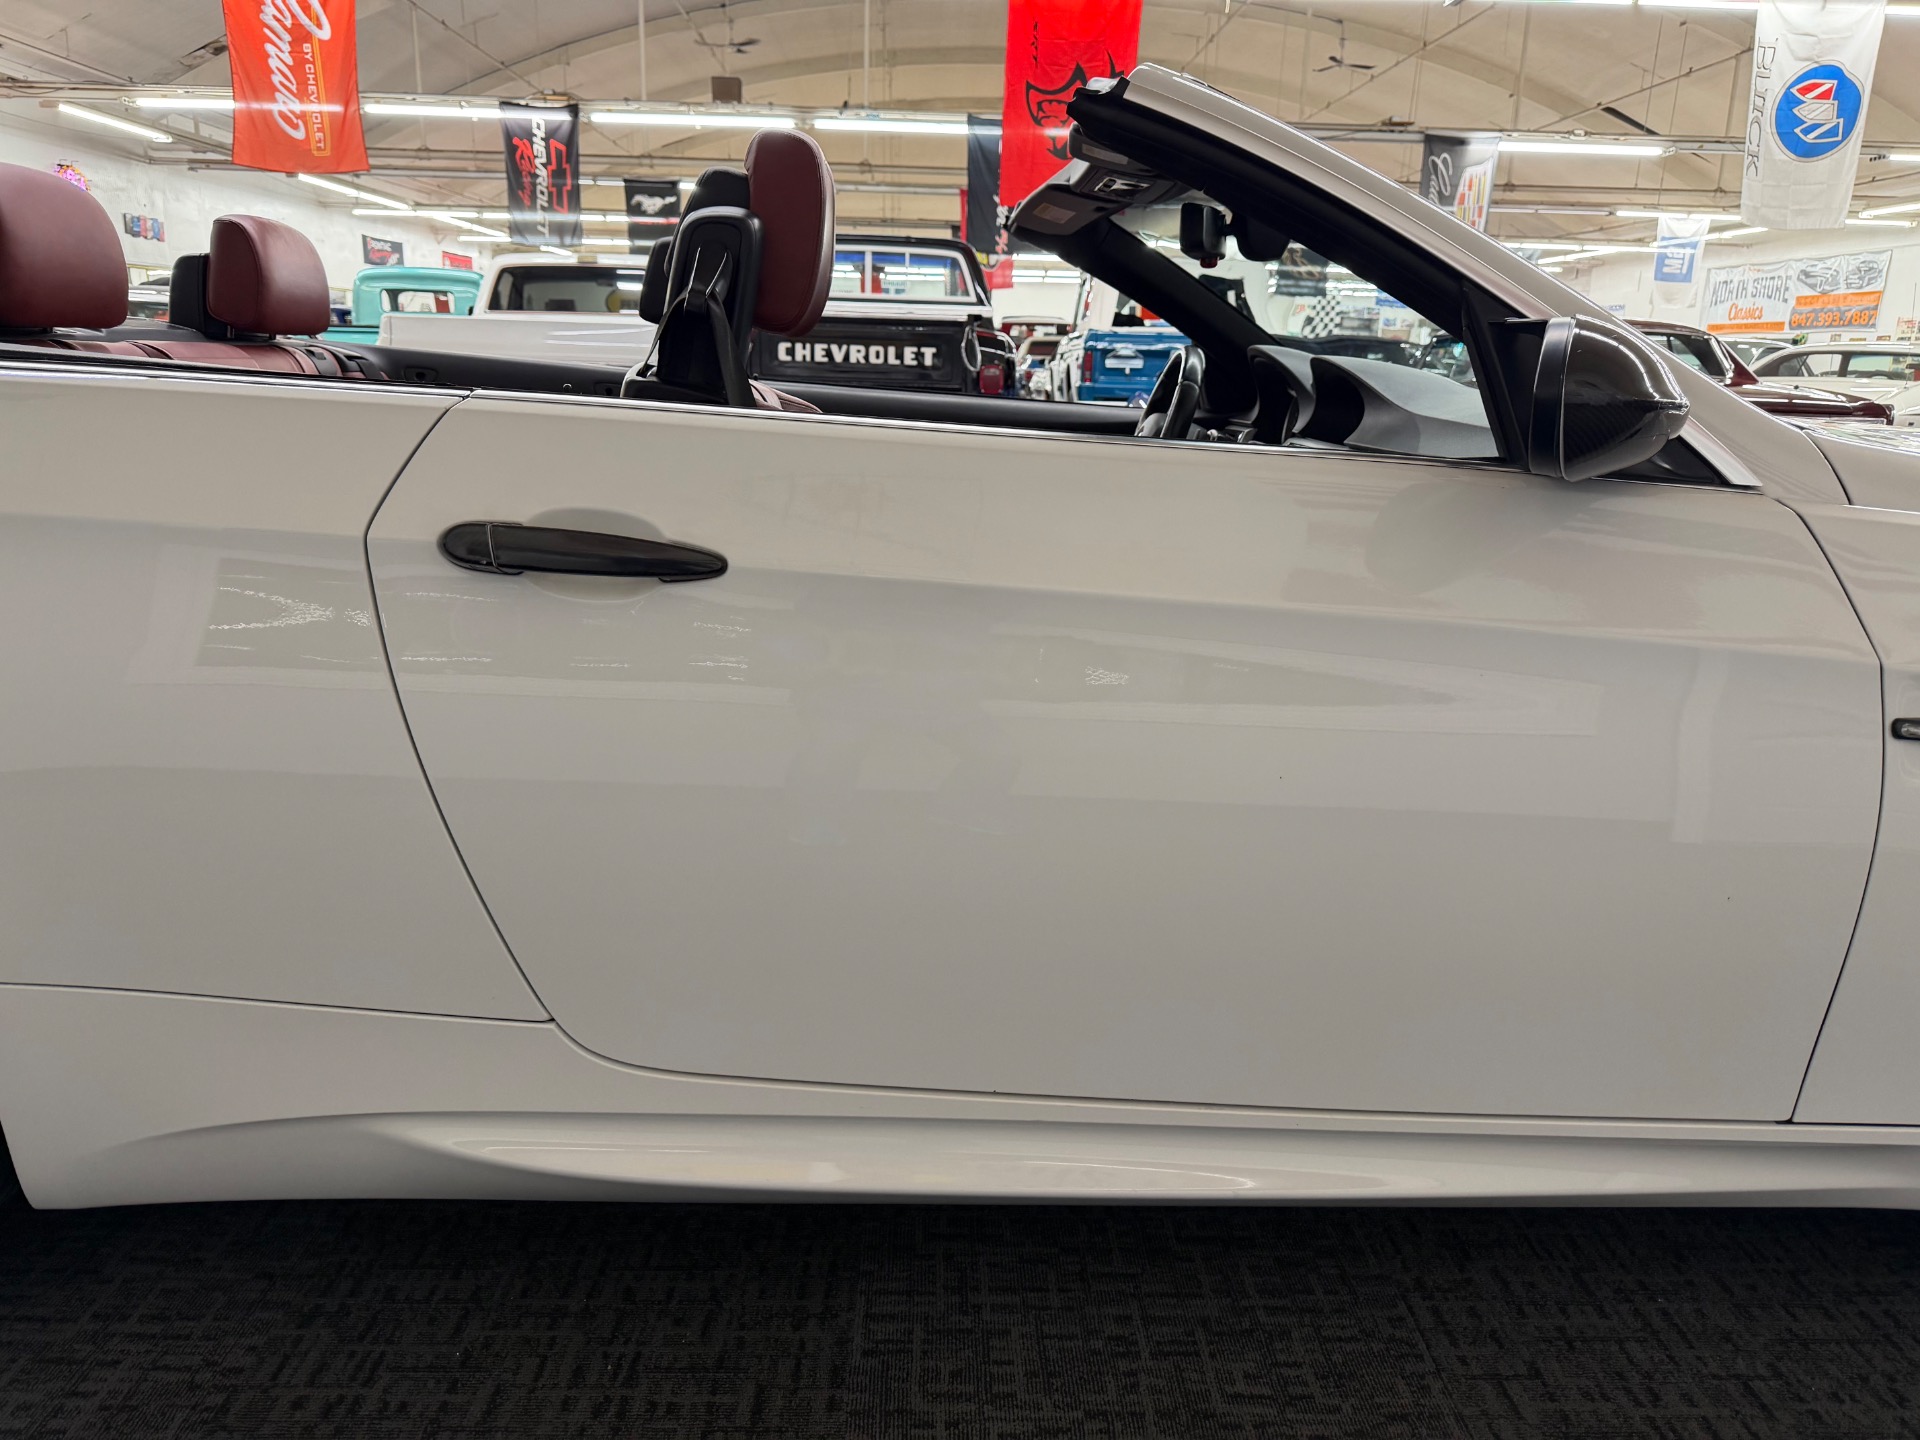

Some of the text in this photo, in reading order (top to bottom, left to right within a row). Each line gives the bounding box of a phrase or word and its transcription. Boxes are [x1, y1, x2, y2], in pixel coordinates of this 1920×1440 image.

[303, 43, 324, 149] BY CHEVOLET
[1746, 37, 1776, 177] BUICK
[1710, 278, 1749, 307] NORTH
[1751, 274, 1792, 304] SHORE
[1728, 301, 1763, 321] Classics
[1791, 310, 1878, 327] 847.393.7887
[777, 342, 937, 367] CHEVROLET
